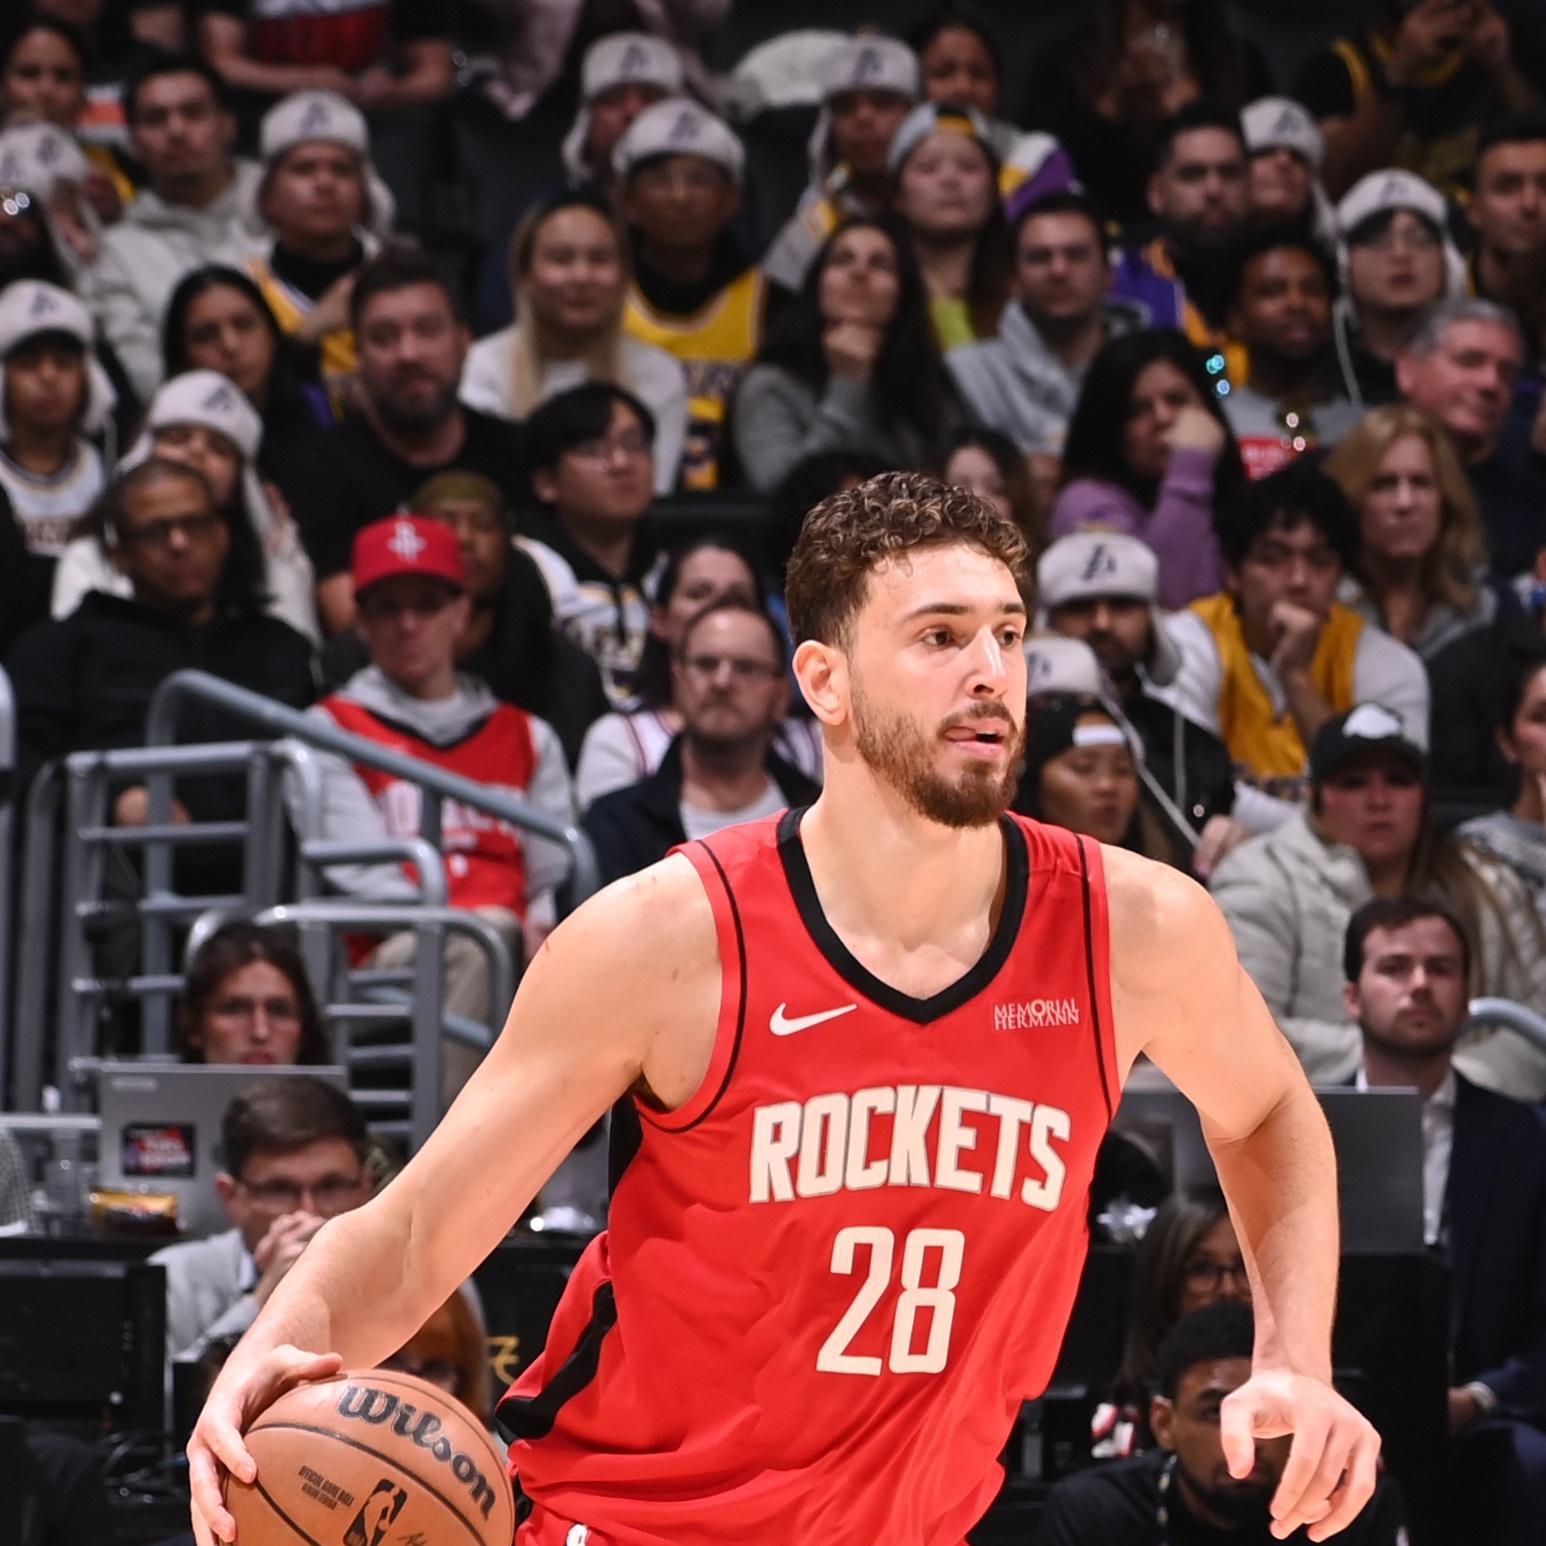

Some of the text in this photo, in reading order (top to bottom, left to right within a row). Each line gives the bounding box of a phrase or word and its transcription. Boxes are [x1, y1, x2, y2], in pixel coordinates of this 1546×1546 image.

[994, 997, 1078, 1019] MEMORIAL
[995, 1009, 1079, 1031] HERMANN
[749, 1084, 1071, 1213] ROCKETS
[815, 1225, 966, 1377] 28
[338, 1385, 496, 1522] Wilson
